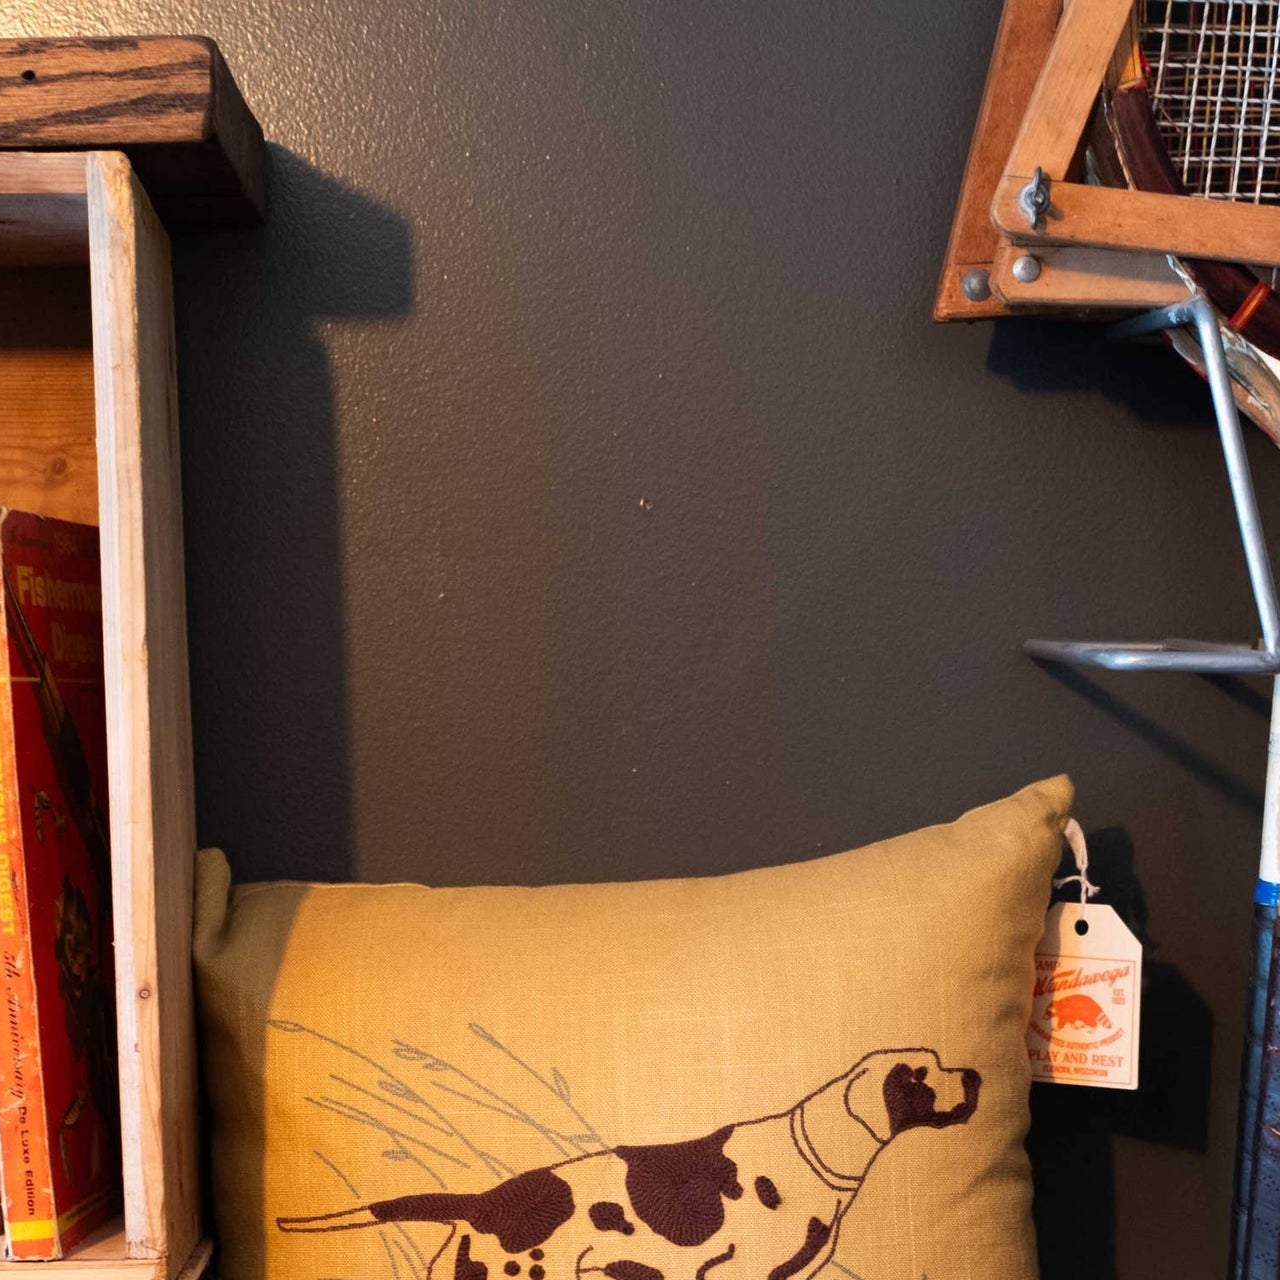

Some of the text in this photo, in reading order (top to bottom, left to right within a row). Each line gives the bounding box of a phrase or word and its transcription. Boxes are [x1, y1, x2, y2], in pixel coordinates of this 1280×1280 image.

[1033, 966, 1131, 997] Wandawega
[1063, 1051, 1088, 1065] AND
[1091, 1054, 1125, 1068] REST
[18, 1106, 28, 1124] De
[20, 1129, 31, 1164] Luxe
[24, 1171, 36, 1216] Edition
